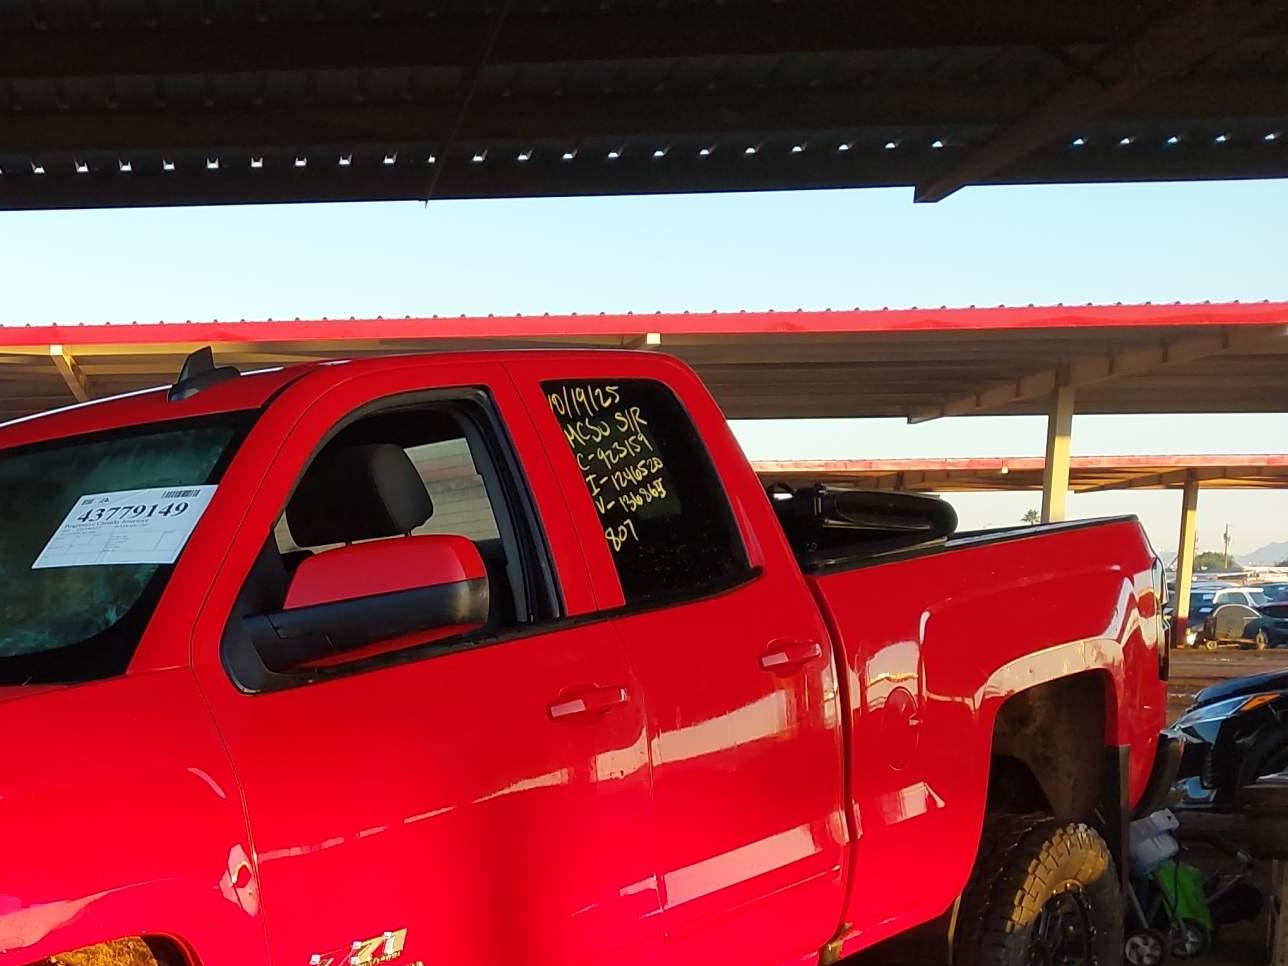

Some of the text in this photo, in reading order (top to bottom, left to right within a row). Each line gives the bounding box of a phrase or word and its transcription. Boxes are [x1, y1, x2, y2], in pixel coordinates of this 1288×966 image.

[548, 385, 620, 417] 10/19/25
[577, 433, 654, 471] C-923159
[76, 502, 189, 522] 43779149
[604, 518, 640, 552] 807
